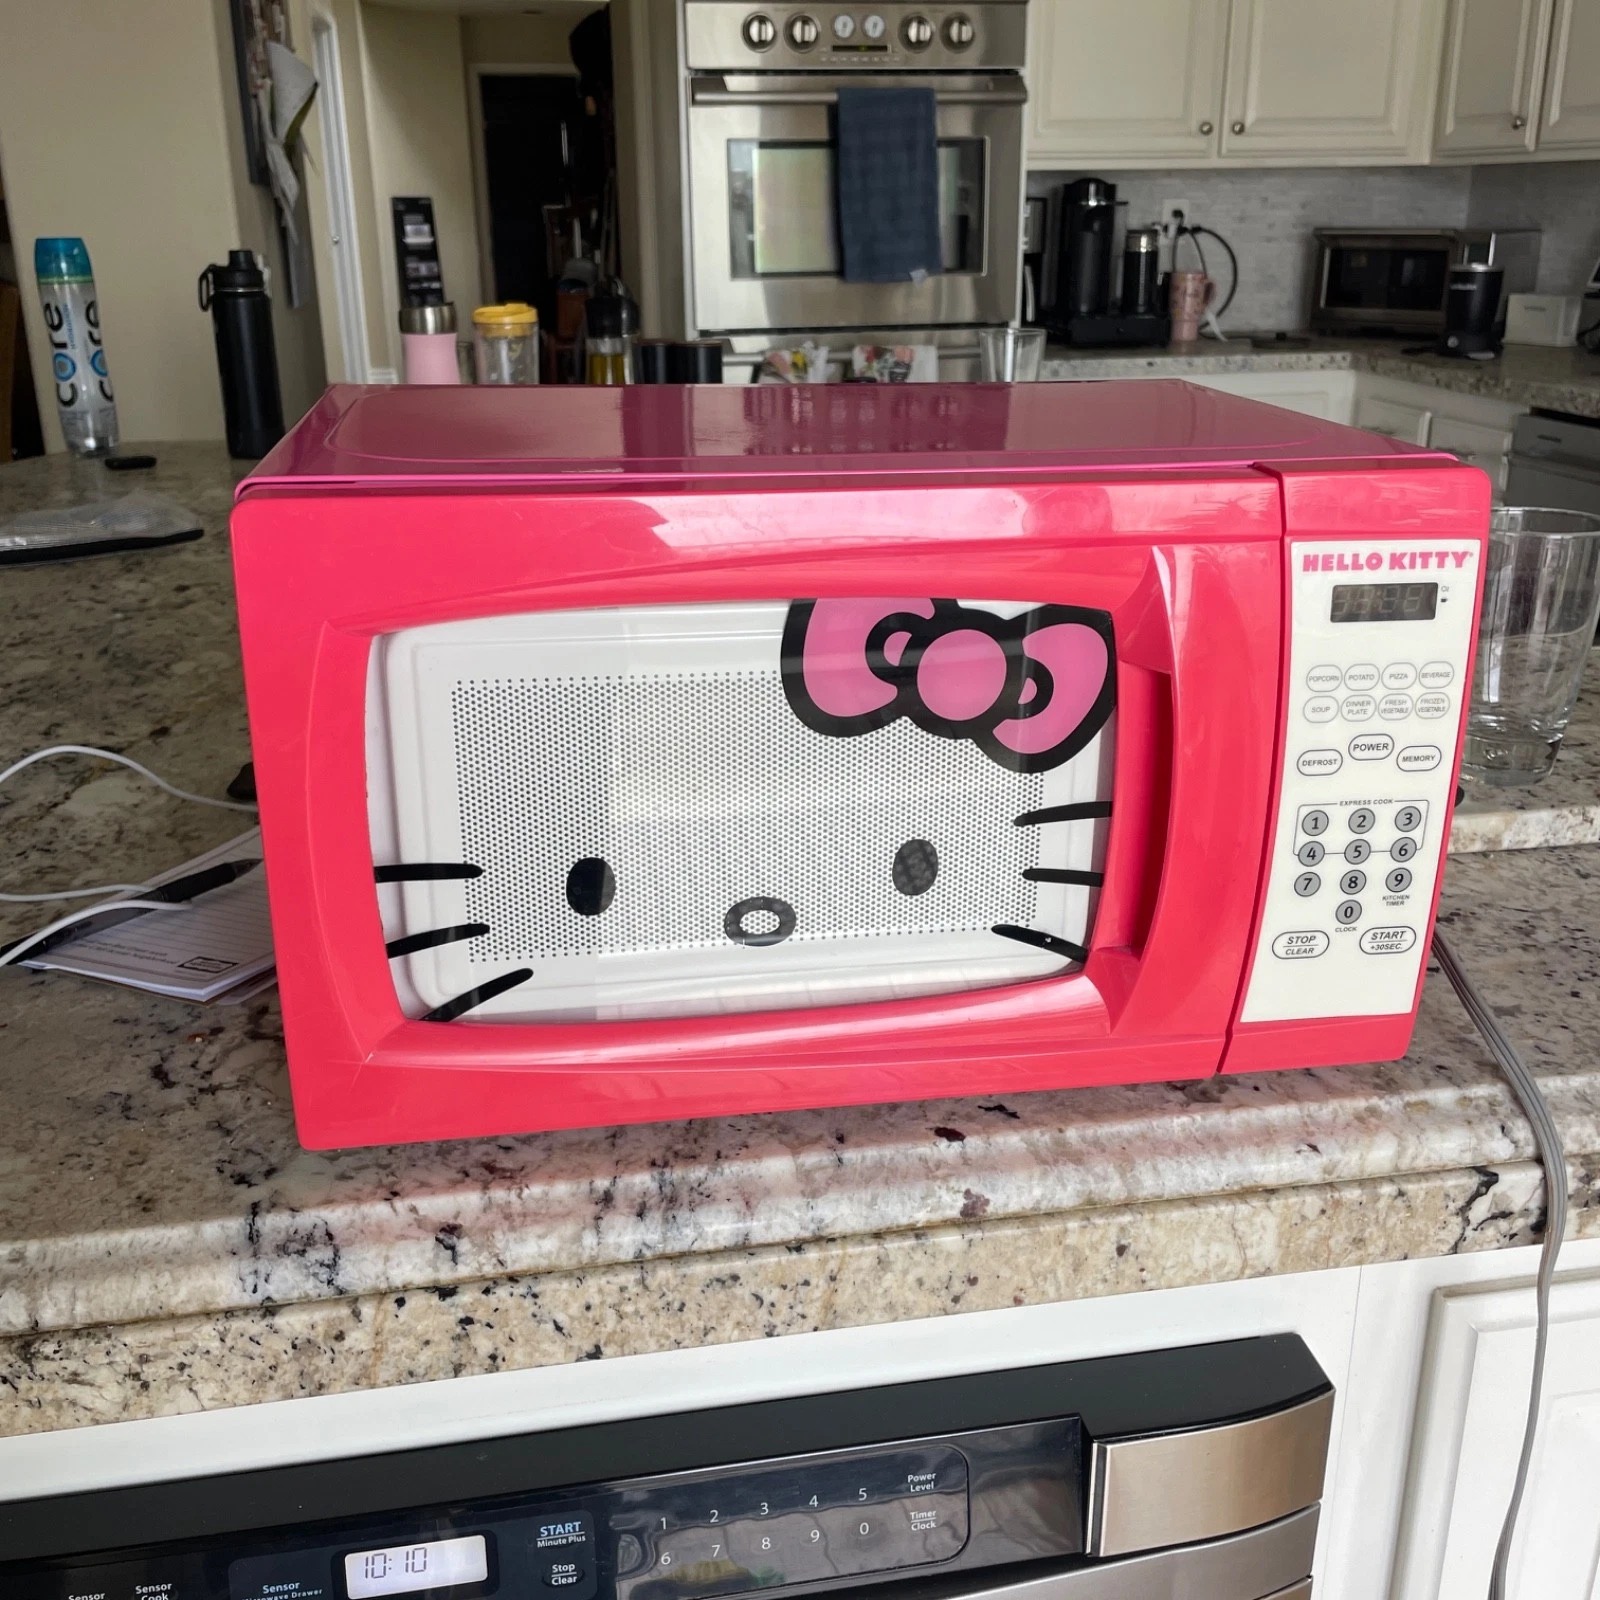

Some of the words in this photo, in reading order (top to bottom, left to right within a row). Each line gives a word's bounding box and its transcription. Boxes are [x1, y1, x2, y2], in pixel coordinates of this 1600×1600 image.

[1302, 552, 1383, 572] HELLO
[1389, 551, 1469, 570] KITTY
[1421, 671, 1451, 679] BEVERAGE
[1420, 697, 1445, 705] FROZEN
[1353, 742, 1389, 752] POWER
[1302, 758, 1338, 767] DEFROST
[1402, 754, 1435, 763] MEMORY
[1311, 816, 1319, 830] 1
[1357, 814, 1367, 828] 2
[1402, 812, 1413, 827] 3
[1306, 847, 1317, 860] 4
[1353, 845, 1362, 858] 5
[1398, 843, 1409, 857] 6
[1303, 877, 1313, 891] 7
[1348, 875, 1358, 889] 8
[1394, 873, 1404, 887] 9
[1343, 906, 1354, 919] 0
[1286, 934, 1316, 945] STOP
[1371, 930, 1407, 941] START
[1285, 946, 1315, 956] CLEAR
[1370, 943, 1403, 951] +30SEC.
[907, 1471, 936, 1484] Power
[910, 1481, 935, 1492] Level
[858, 1487, 867, 1501] 5
[809, 1494, 819, 1508] 4
[760, 1502, 769, 1516] 3
[910, 1509, 937, 1522] Timer
[710, 1509, 719, 1523] 2
[540, 1521, 582, 1537] START
[661, 1517, 667, 1530] 1
[859, 1522, 869, 1536] 0
[911, 1519, 937, 1532] Clock
[537, 1537, 567, 1548] Minute
[568, 1534, 586, 1545] Plus
[810, 1529, 820, 1543] 9
[761, 1536, 771, 1550] 8
[711, 1544, 721, 1558] 7
[364, 1546, 428, 1579] 10:10
[661, 1552, 671, 1566] 6
[552, 1563, 576, 1575] Stop
[262, 1580, 300, 1594] Sensor
[551, 1575, 578, 1586] Clear
[135, 1583, 173, 1595] Sensor
[291, 1587, 323, 1598] Drawer
